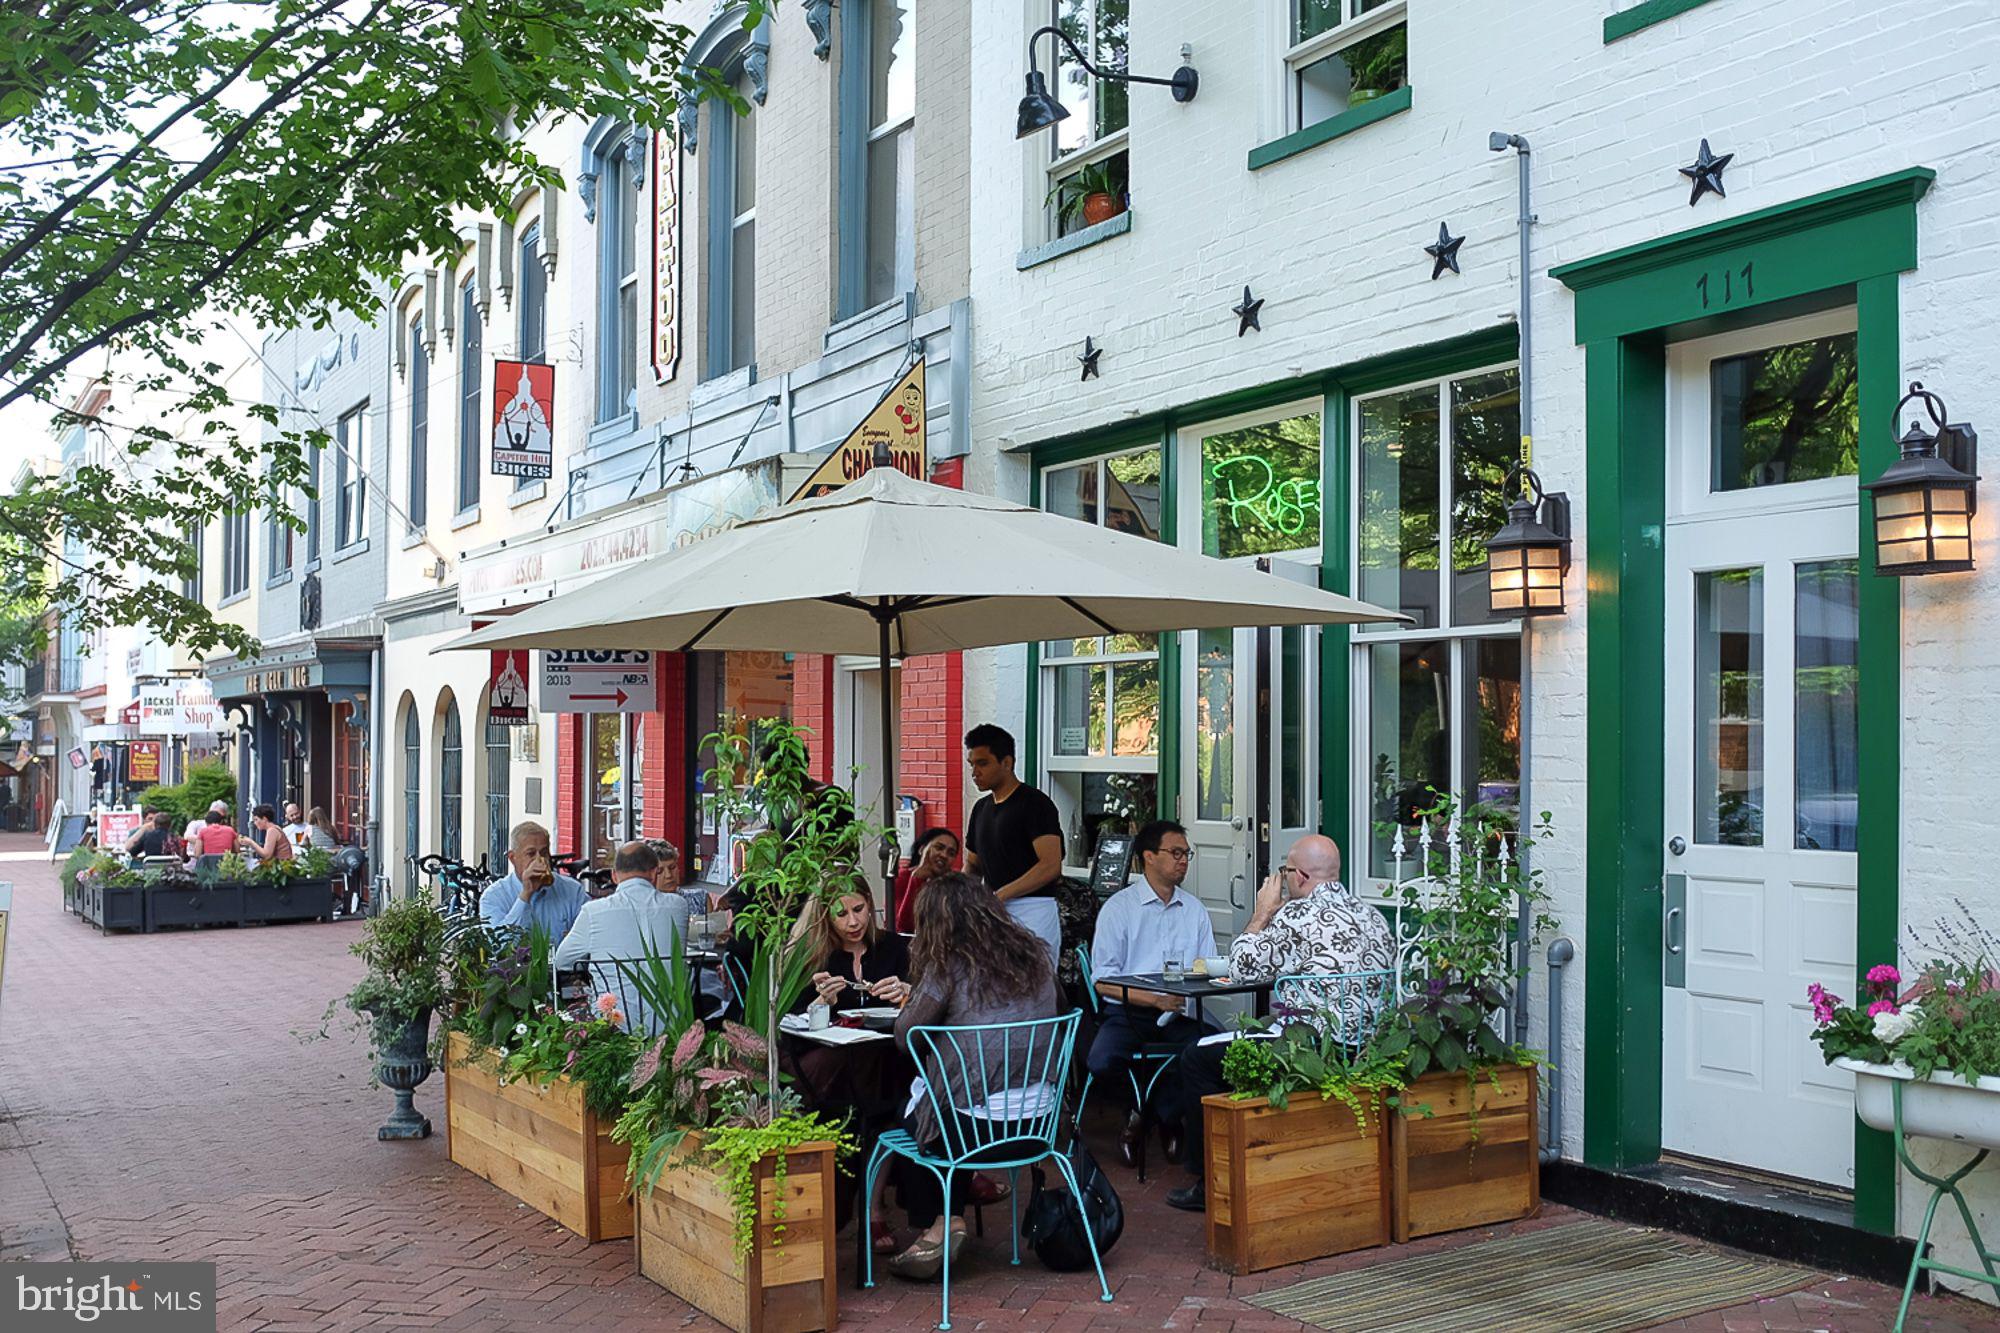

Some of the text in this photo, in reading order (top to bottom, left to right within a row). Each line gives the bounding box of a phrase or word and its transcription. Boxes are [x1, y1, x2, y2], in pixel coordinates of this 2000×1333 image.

[495, 451, 548, 464] CAPITOL HILL
[842, 448, 921, 481] CHAPION
[493, 461, 551, 478] BIKES
[546, 675, 572, 686] 2013
[185, 708, 213, 729] Shop
[491, 716, 528, 725] BIKES
